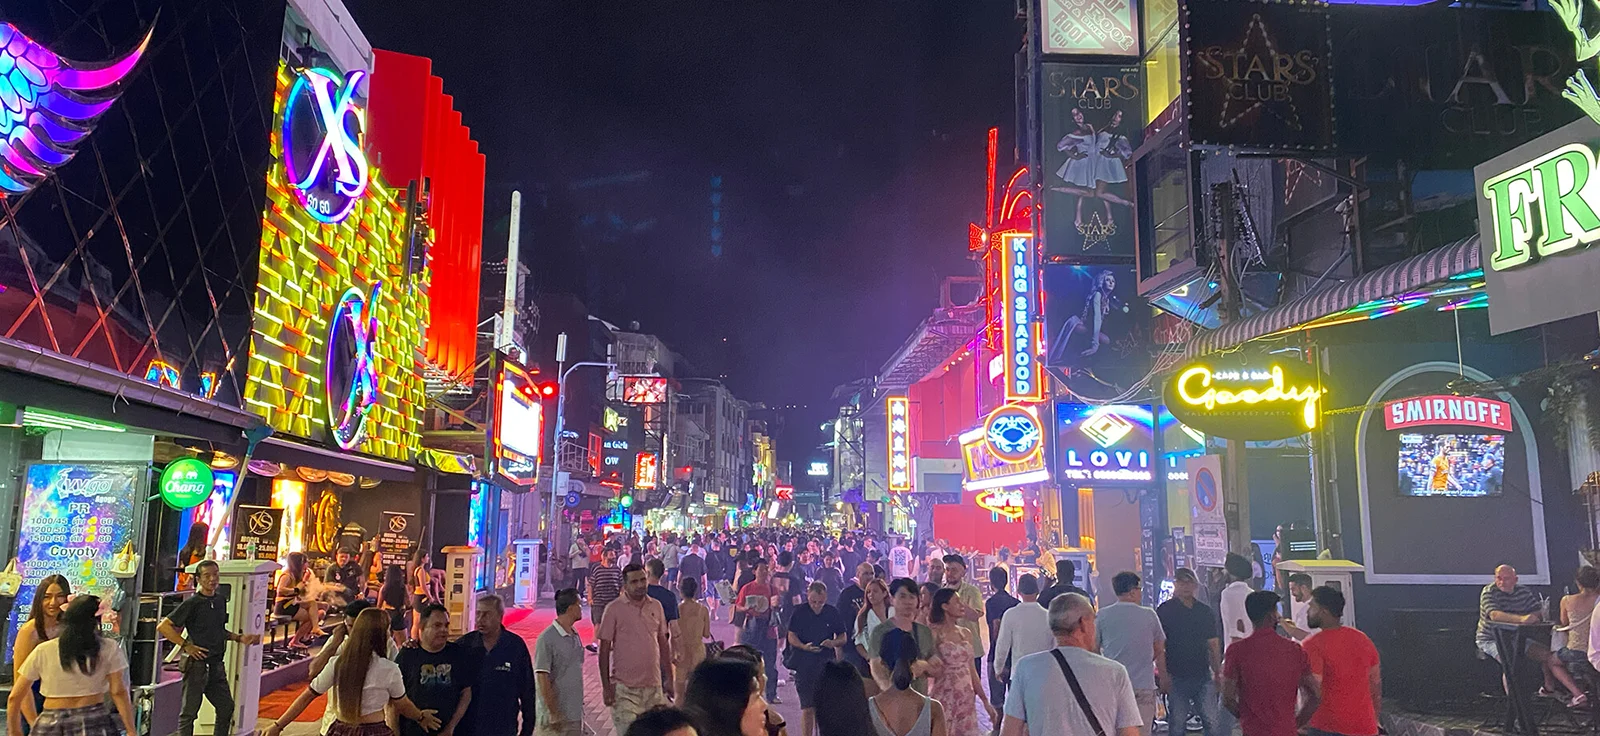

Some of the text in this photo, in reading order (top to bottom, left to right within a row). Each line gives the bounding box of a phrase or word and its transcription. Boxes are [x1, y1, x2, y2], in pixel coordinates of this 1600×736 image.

[1085, 3, 1134, 51] Roof
[1198, 45, 1318, 85] STARS
[1049, 72, 1139, 100] STARS
[1229, 83, 1289, 101] CLUB
[1078, 98, 1112, 109] CLUB
[297, 68, 368, 197] XS
[320, 200, 330, 214] GO
[1077, 223, 1117, 235] STARS
[1012, 238, 1030, 394] KING SEAFOOD
[1178, 365, 1321, 429] Goody
[165, 480, 205, 494] Chang
[69, 503, 90, 513] PR
[50, 546, 98, 559] Coyoty
